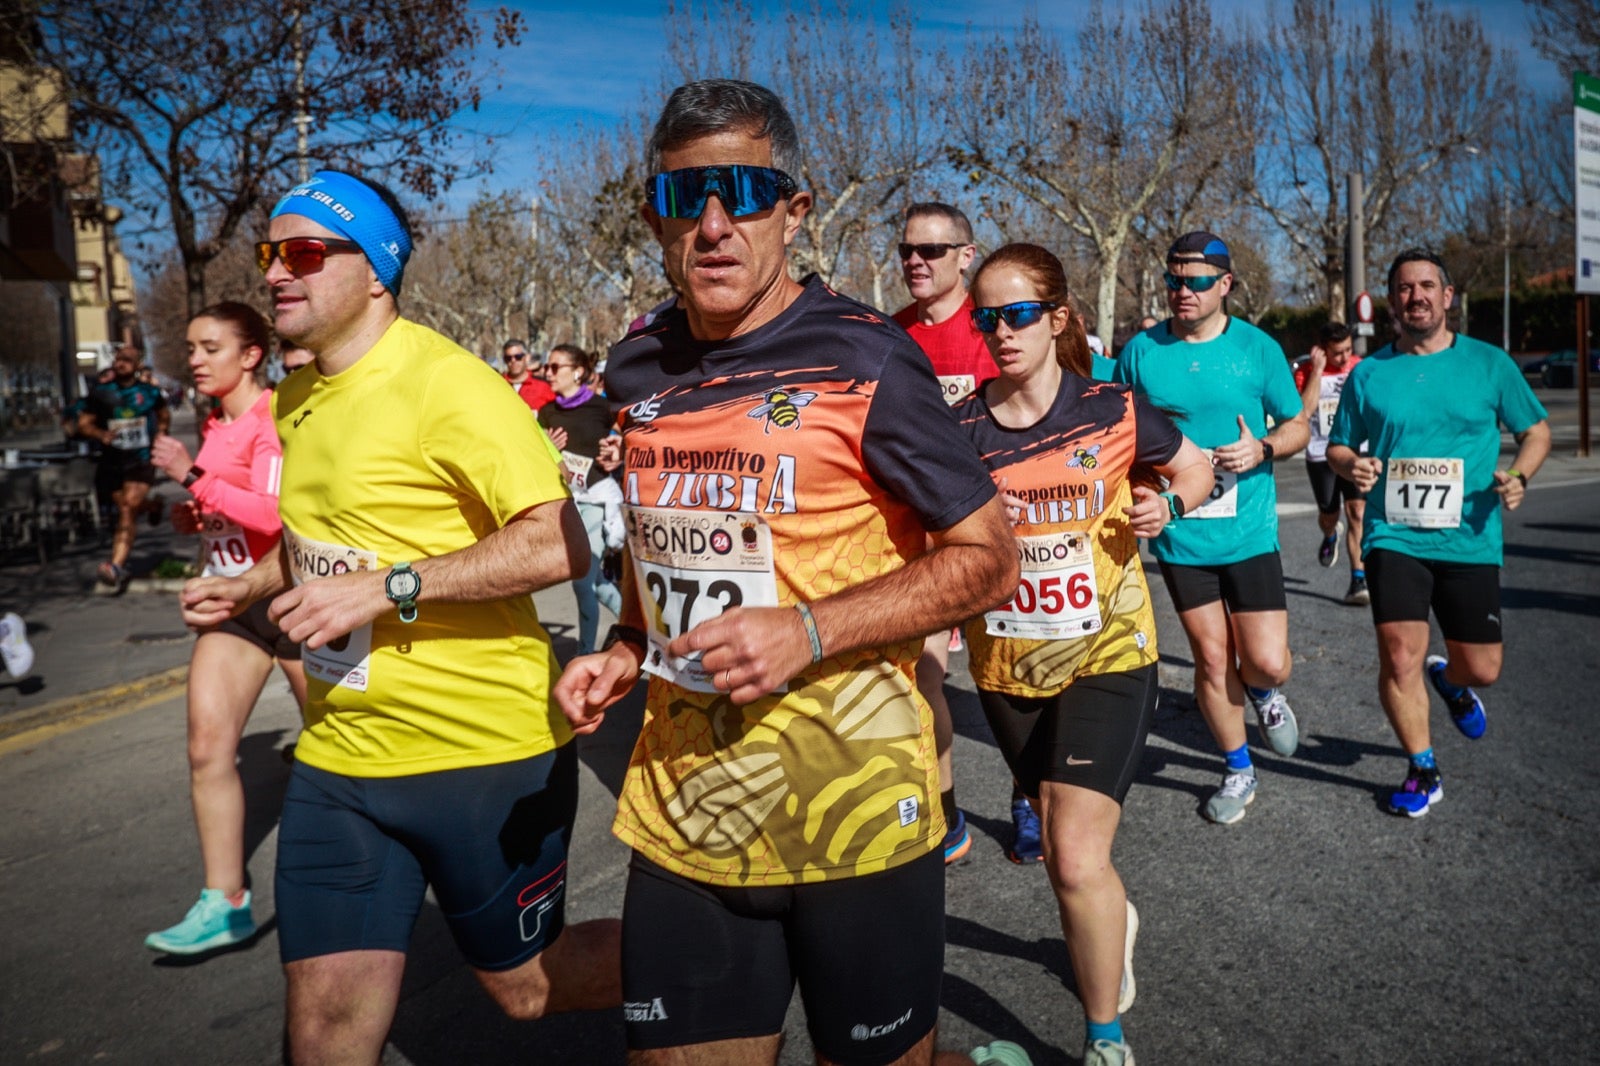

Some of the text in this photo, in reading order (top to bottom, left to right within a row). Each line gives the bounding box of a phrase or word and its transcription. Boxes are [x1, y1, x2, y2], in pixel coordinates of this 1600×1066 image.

[310, 191, 355, 222] SILOS
[628, 447, 766, 474] Club Deportivo
[656, 453, 798, 514] ZUBIA
[1397, 482, 1452, 510] 177
[642, 521, 733, 555] FONDO
[713, 537, 728, 548] 24
[292, 547, 350, 577] ONDO
[990, 573, 1093, 615] 056
